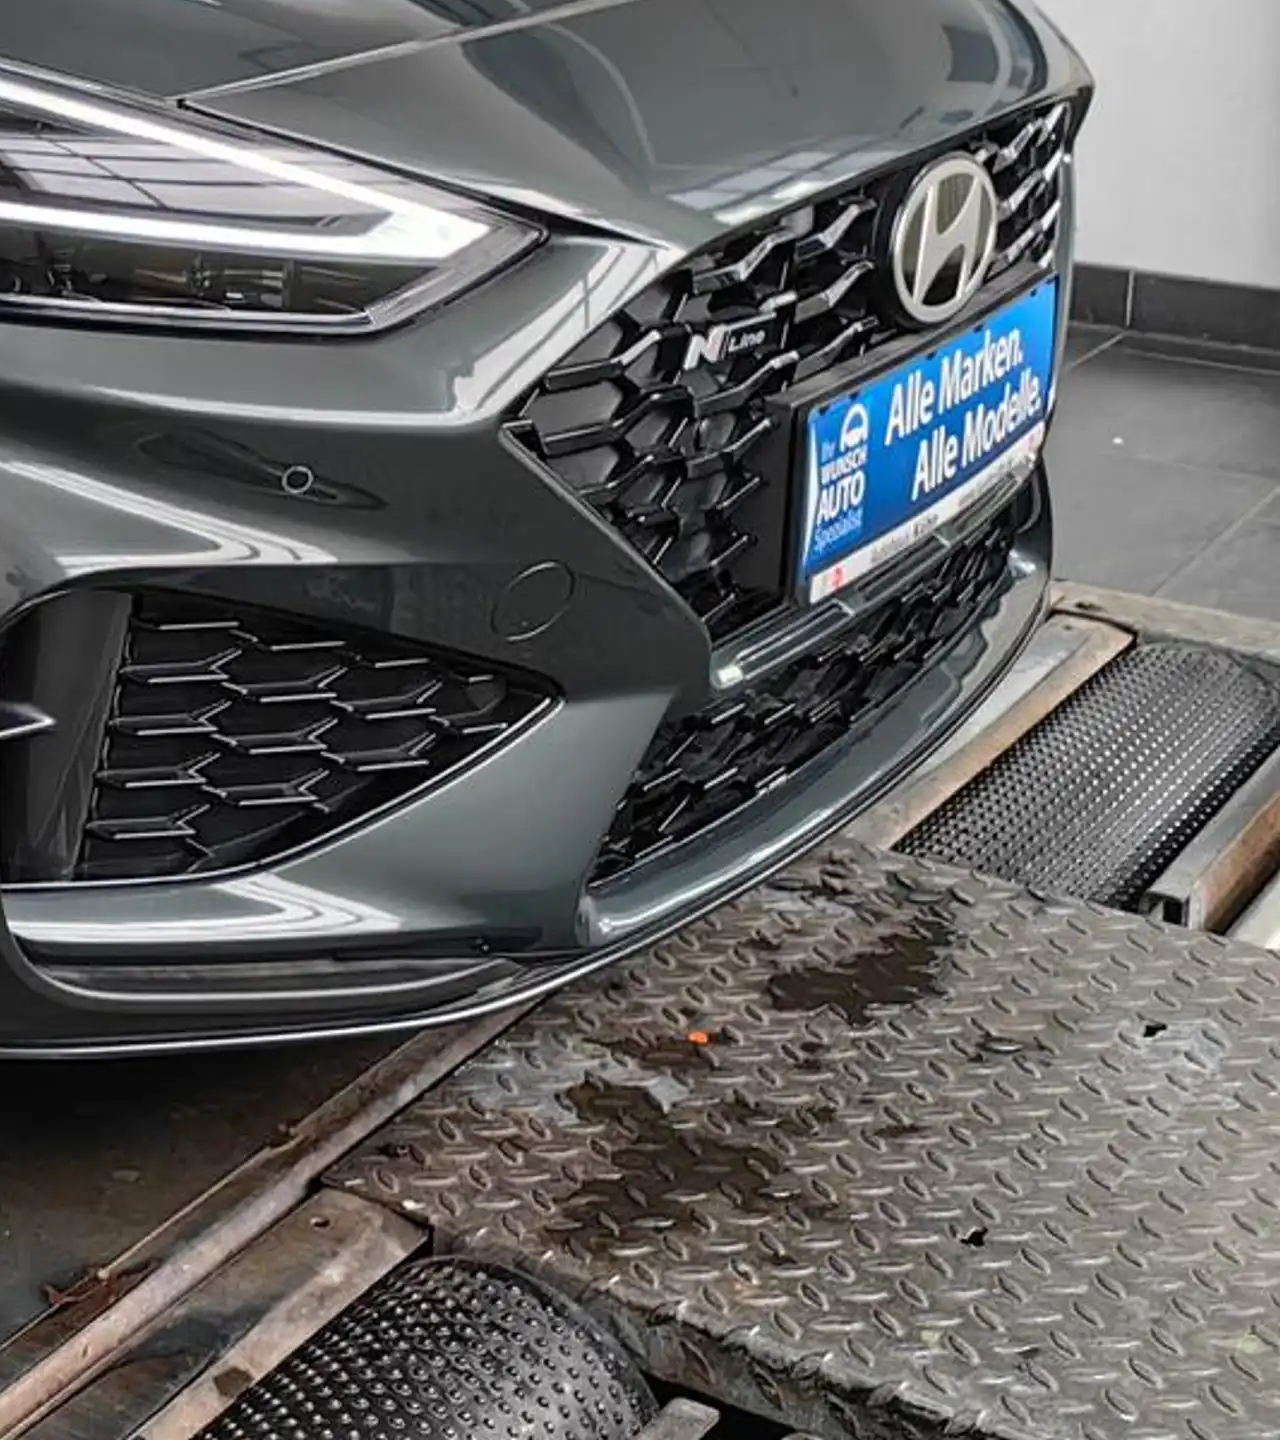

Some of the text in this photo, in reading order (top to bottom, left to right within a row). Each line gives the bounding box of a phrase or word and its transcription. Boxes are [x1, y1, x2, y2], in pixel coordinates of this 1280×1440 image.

[884, 327, 1024, 446] Alle Marken.
[911, 422, 959, 501] Alle
[962, 371, 1042, 470] Modelle.
[815, 474, 867, 524] AUTO
